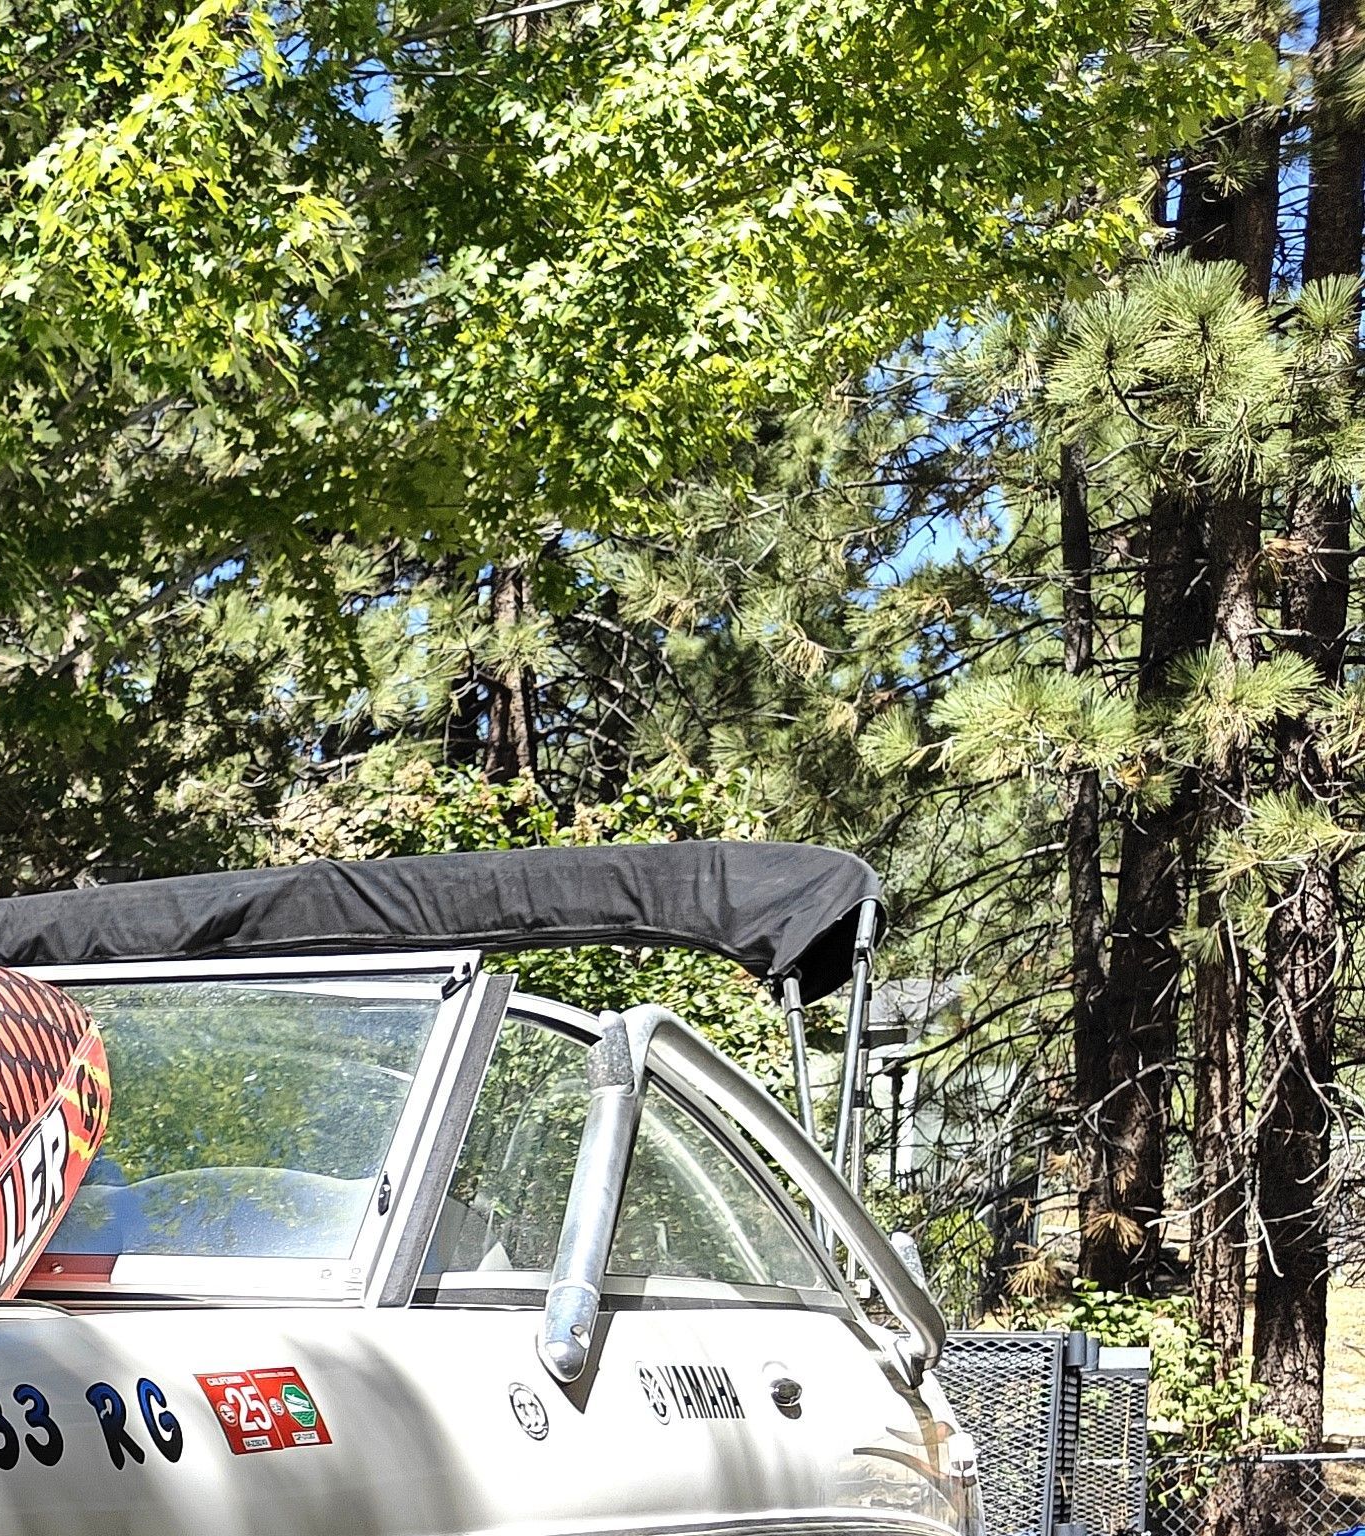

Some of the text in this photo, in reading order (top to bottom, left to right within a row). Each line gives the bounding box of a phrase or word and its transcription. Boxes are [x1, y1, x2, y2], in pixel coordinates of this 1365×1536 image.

[224, 1385, 273, 1433] 25
[655, 1365, 746, 1419] YAMAHA
[86, 1377, 184, 1470] RG
